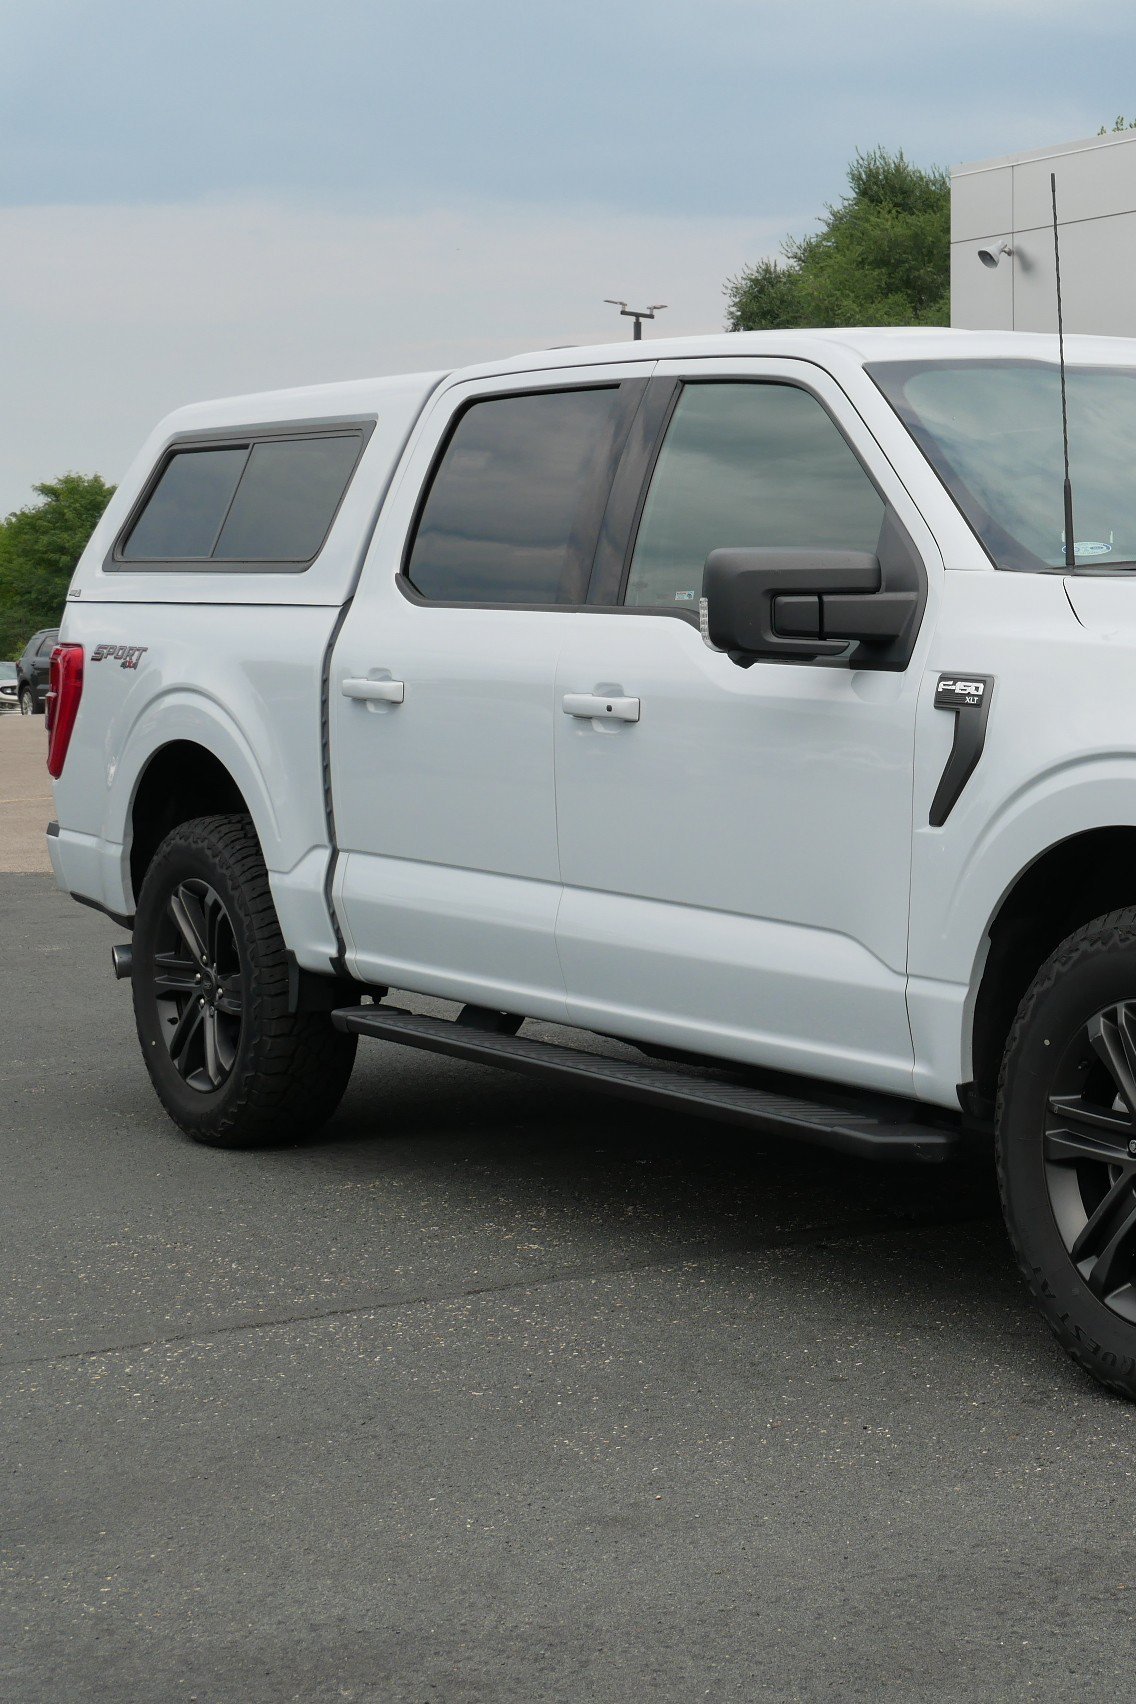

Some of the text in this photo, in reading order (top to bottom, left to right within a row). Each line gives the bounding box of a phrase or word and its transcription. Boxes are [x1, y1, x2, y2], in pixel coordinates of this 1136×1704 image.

[91, 643, 148, 662] SPORT
[938, 681, 985, 695] F-150
[965, 696, 979, 704] XLT
